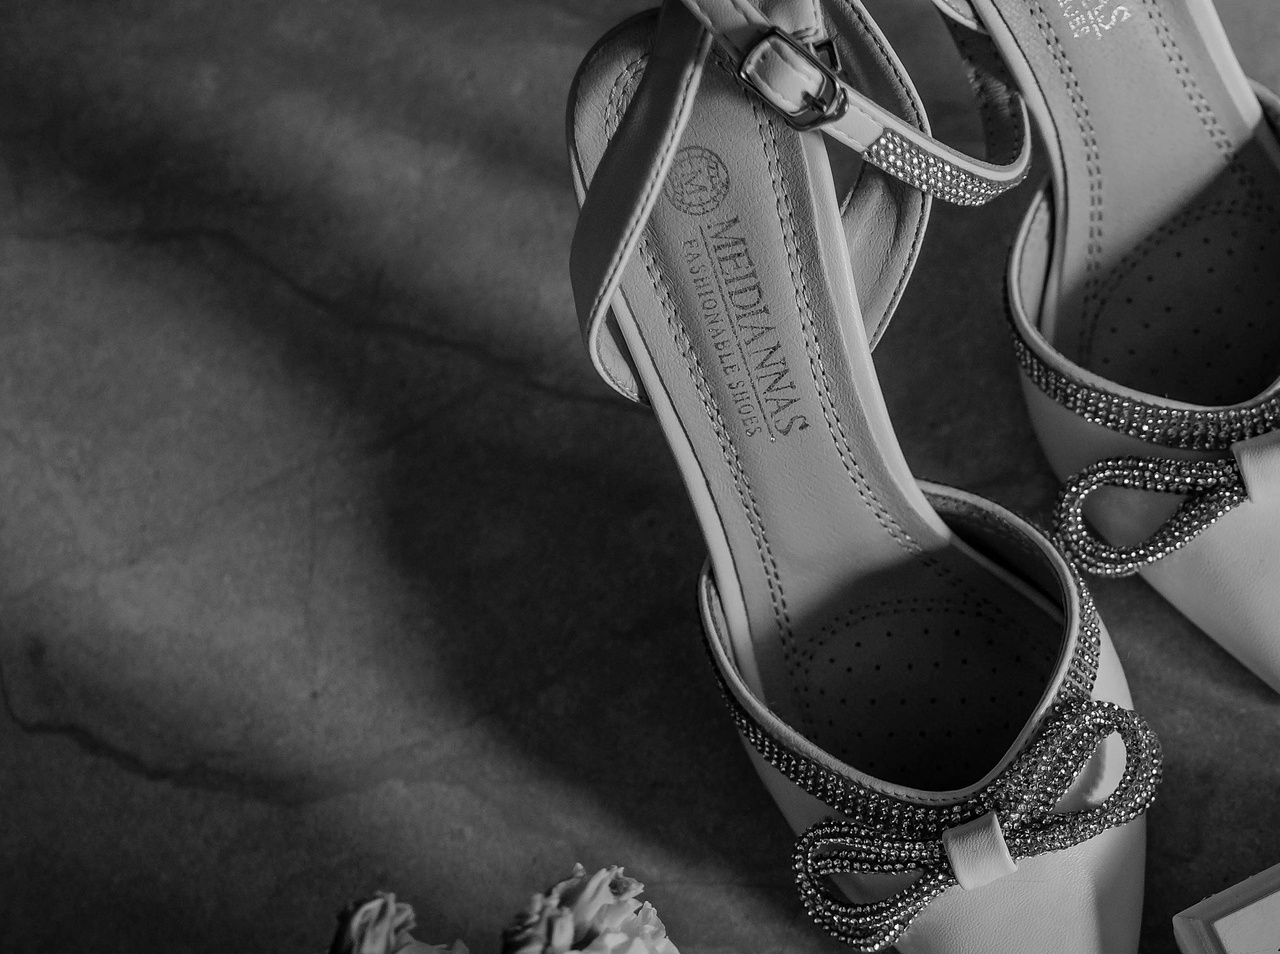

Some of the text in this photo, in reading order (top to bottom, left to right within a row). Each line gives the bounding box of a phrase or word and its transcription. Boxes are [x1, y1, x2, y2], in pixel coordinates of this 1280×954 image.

[681, 238, 762, 437] FASHIONABLE SHOES
[706, 215, 811, 436] MEIDIANNAS
